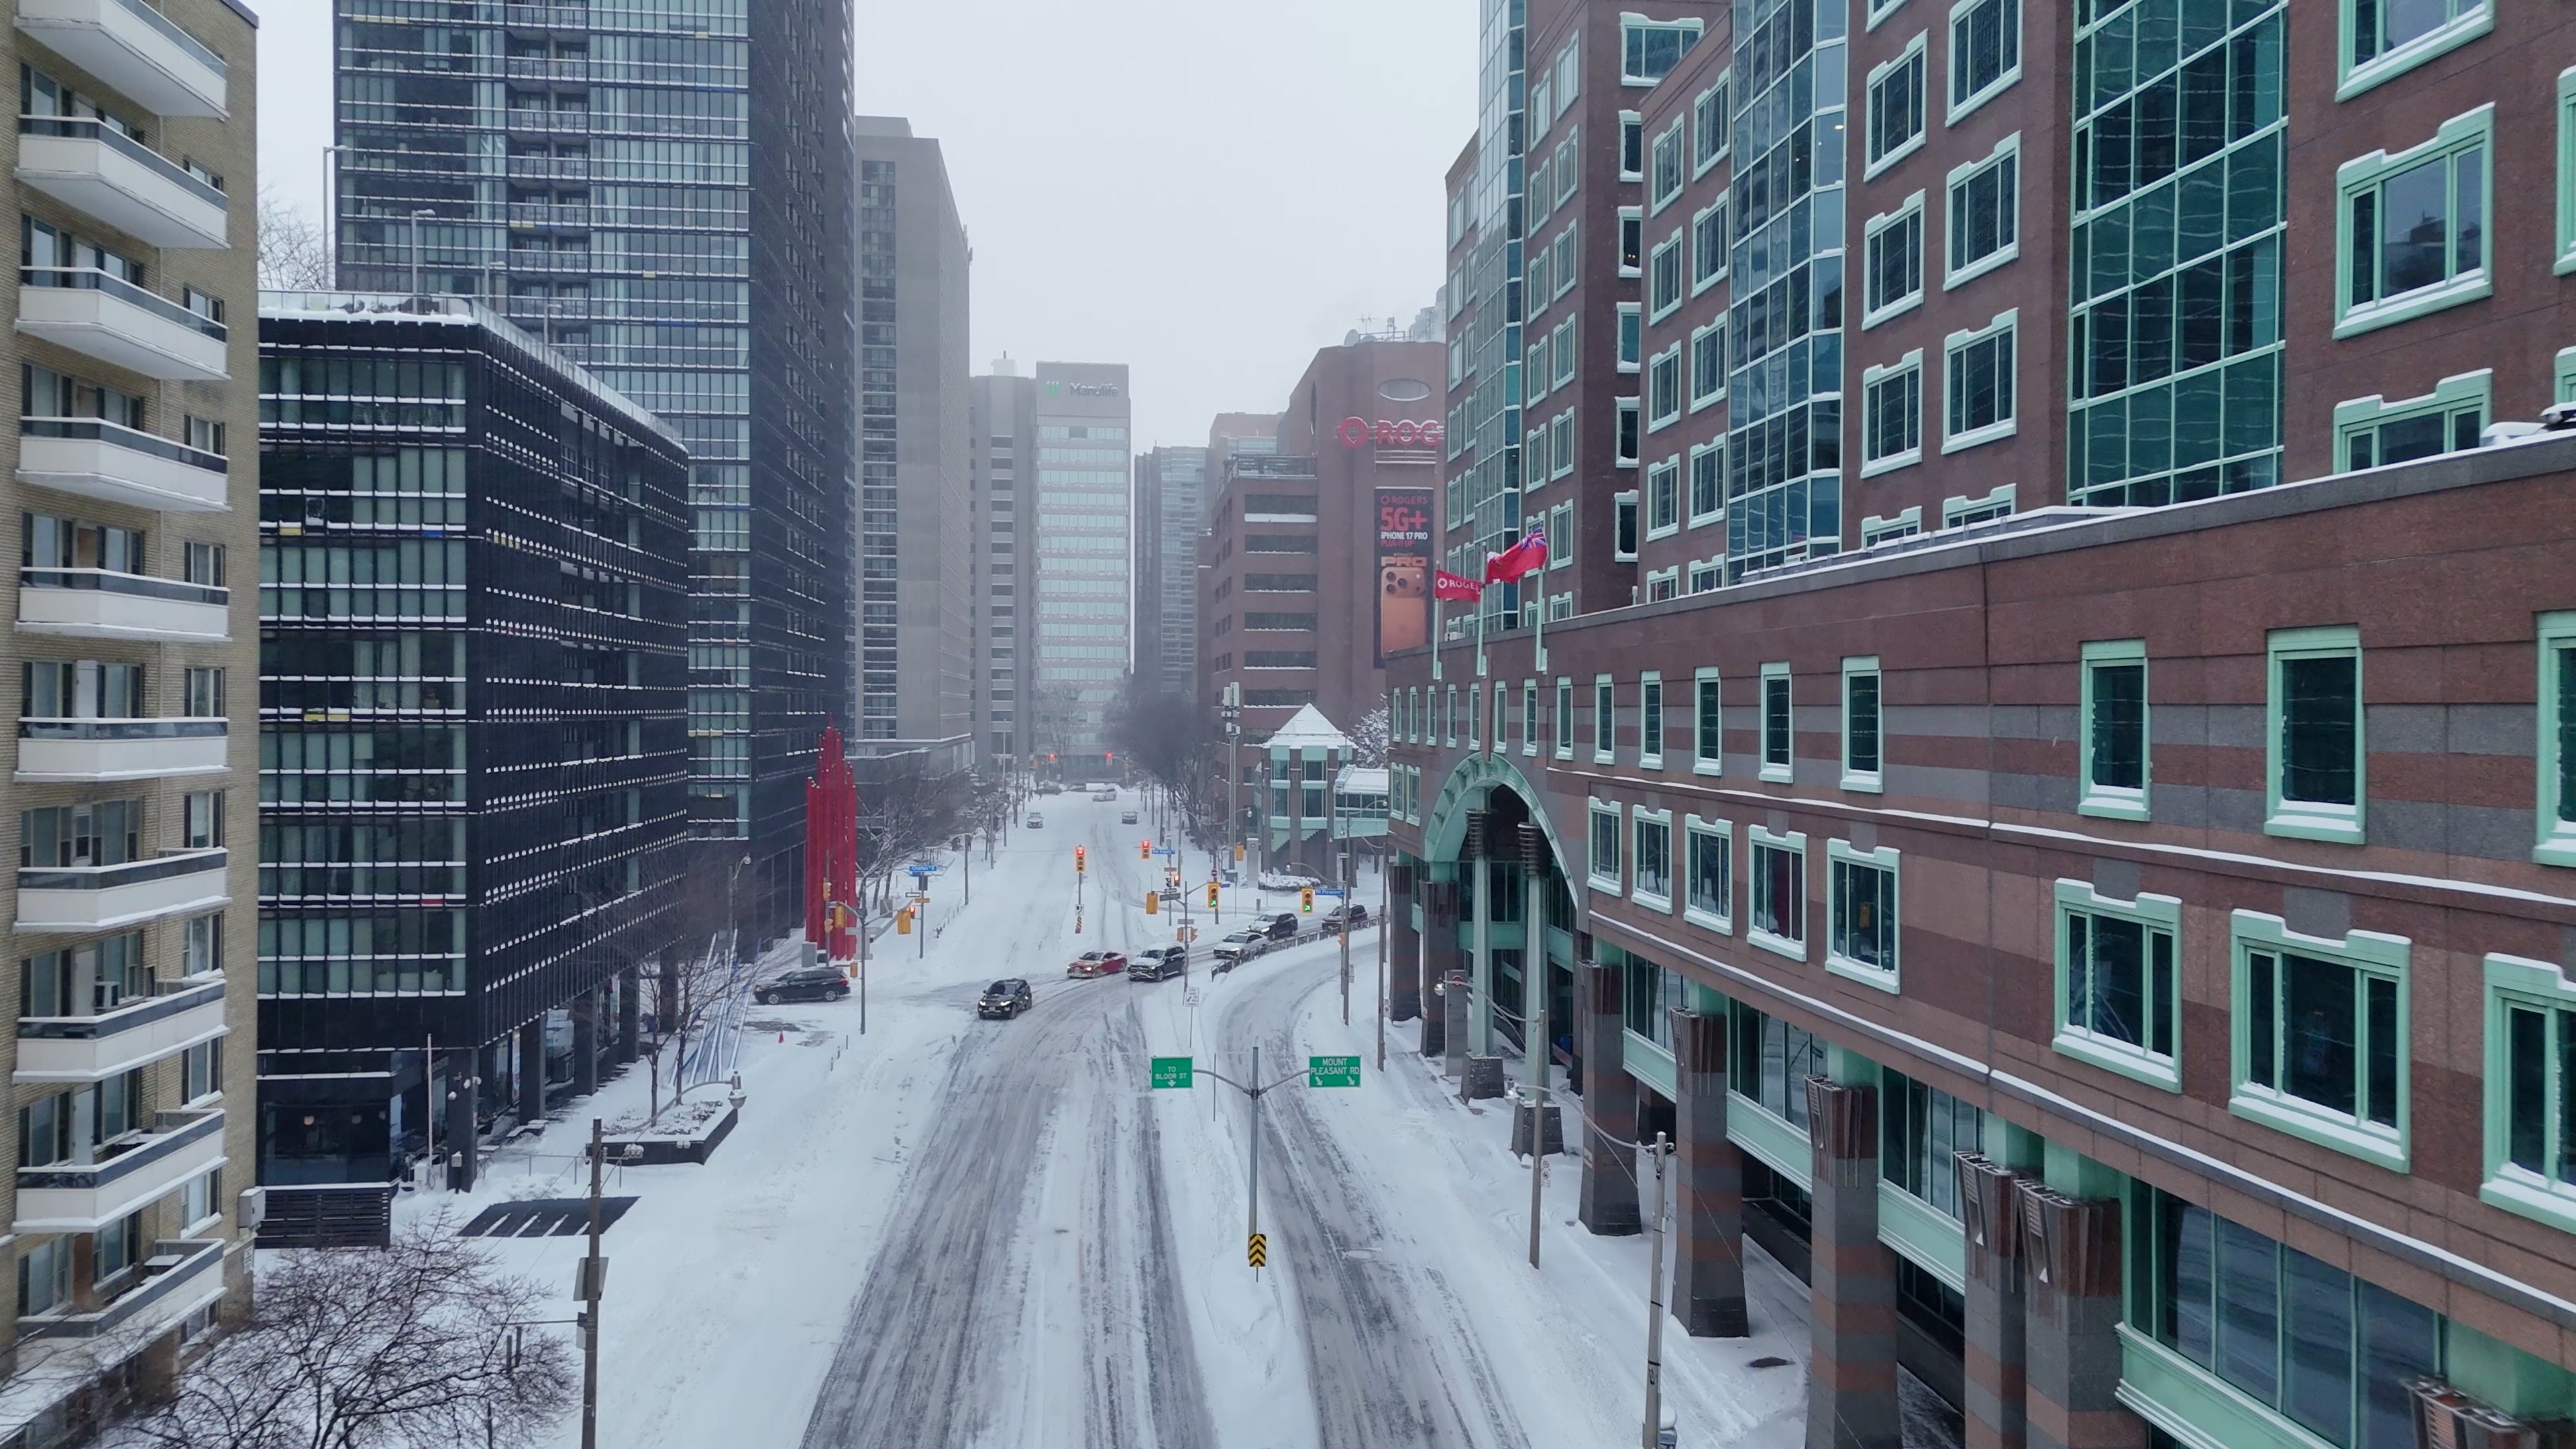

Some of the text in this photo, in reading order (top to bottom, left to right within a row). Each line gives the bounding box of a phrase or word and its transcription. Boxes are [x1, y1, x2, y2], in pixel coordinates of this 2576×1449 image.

[1070, 382, 1119, 398] Manulife
[1377, 419, 1440, 446] ROG
[1392, 496, 1428, 505] ROGERS
[1381, 506, 1428, 532] 5G+
[1381, 531, 1429, 540] iPHONE 17 PRO
[1381, 556, 1428, 567] PRO
[1449, 579, 1479, 592] ROGE
[1322, 1058, 1348, 1066] MOUNT
[1310, 1066, 1360, 1075] PLEASANT RD
